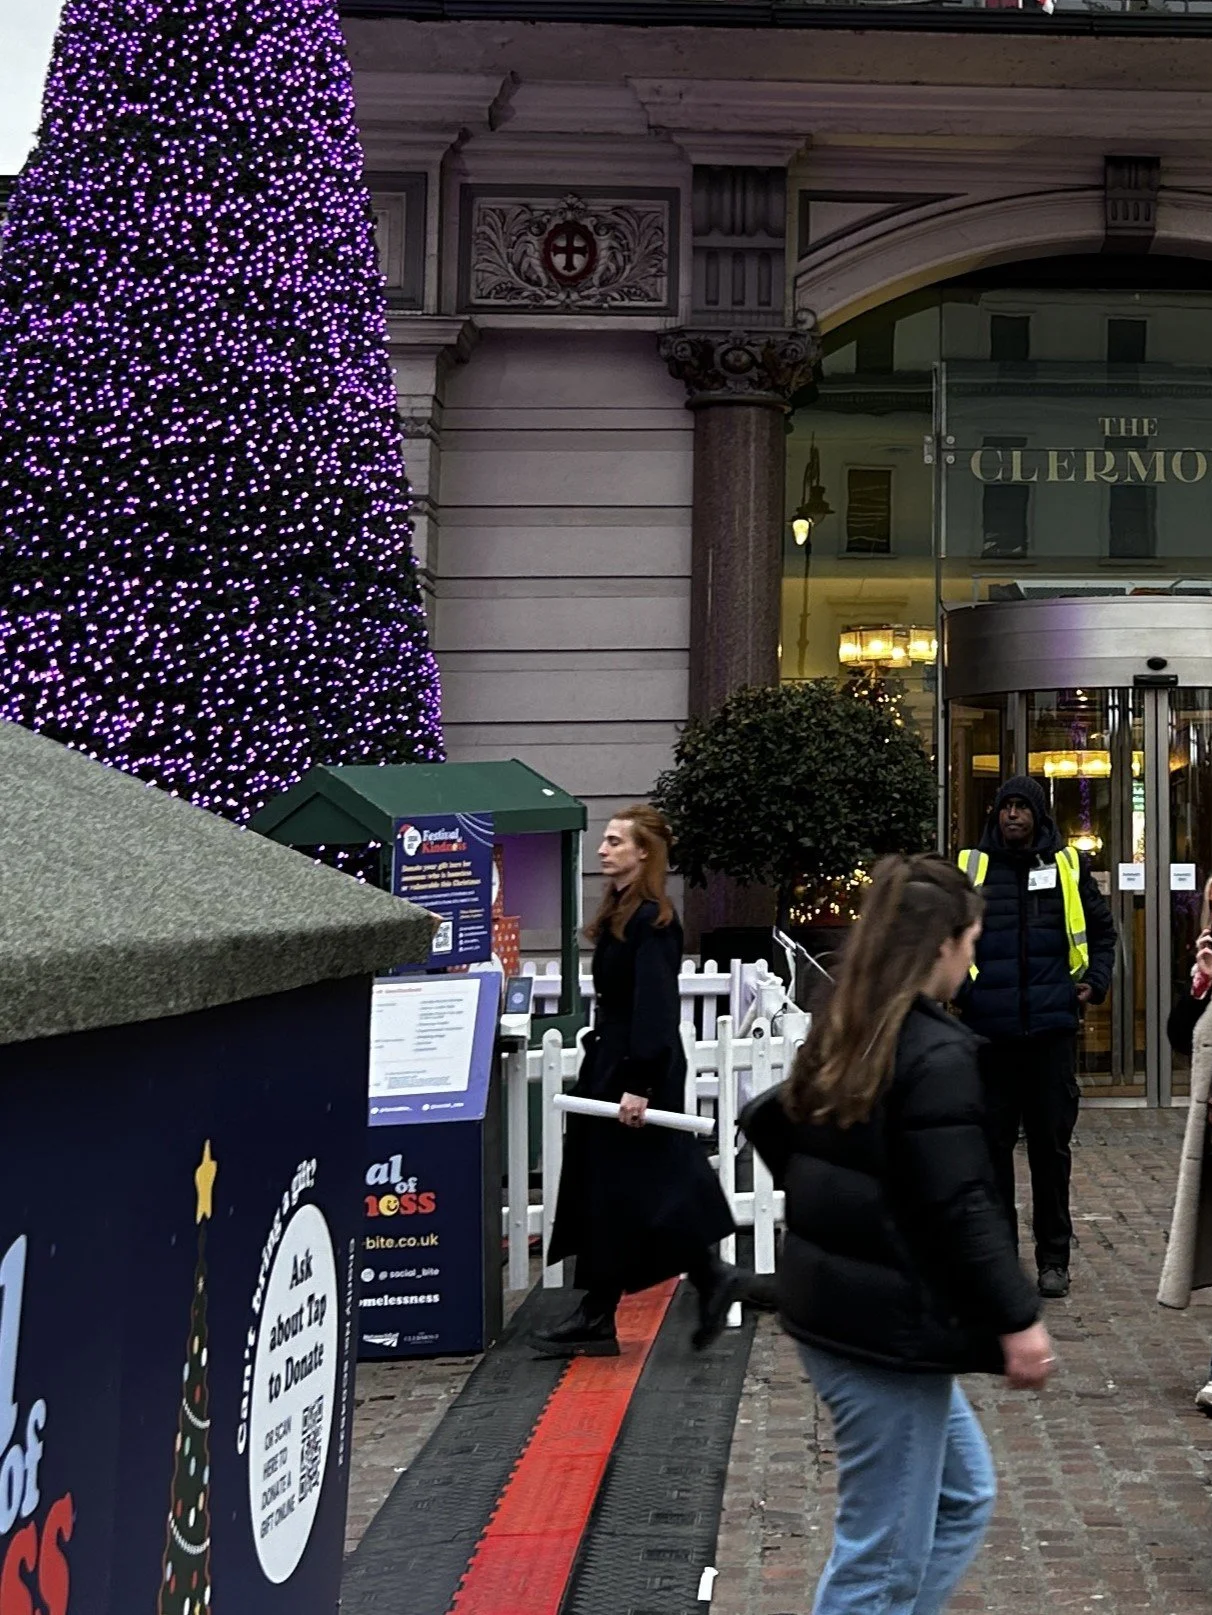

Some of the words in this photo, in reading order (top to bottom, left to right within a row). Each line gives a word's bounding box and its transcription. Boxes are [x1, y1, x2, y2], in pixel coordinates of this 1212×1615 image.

[1098, 417, 1159, 437] THE
[395, 1177, 418, 1194] of
[289, 1247, 314, 1290] Ask
[269, 1303, 303, 1352] about
[306, 1292, 327, 1327] Tap
[268, 1372, 282, 1403] to
[283, 1341, 324, 1393] Donate
